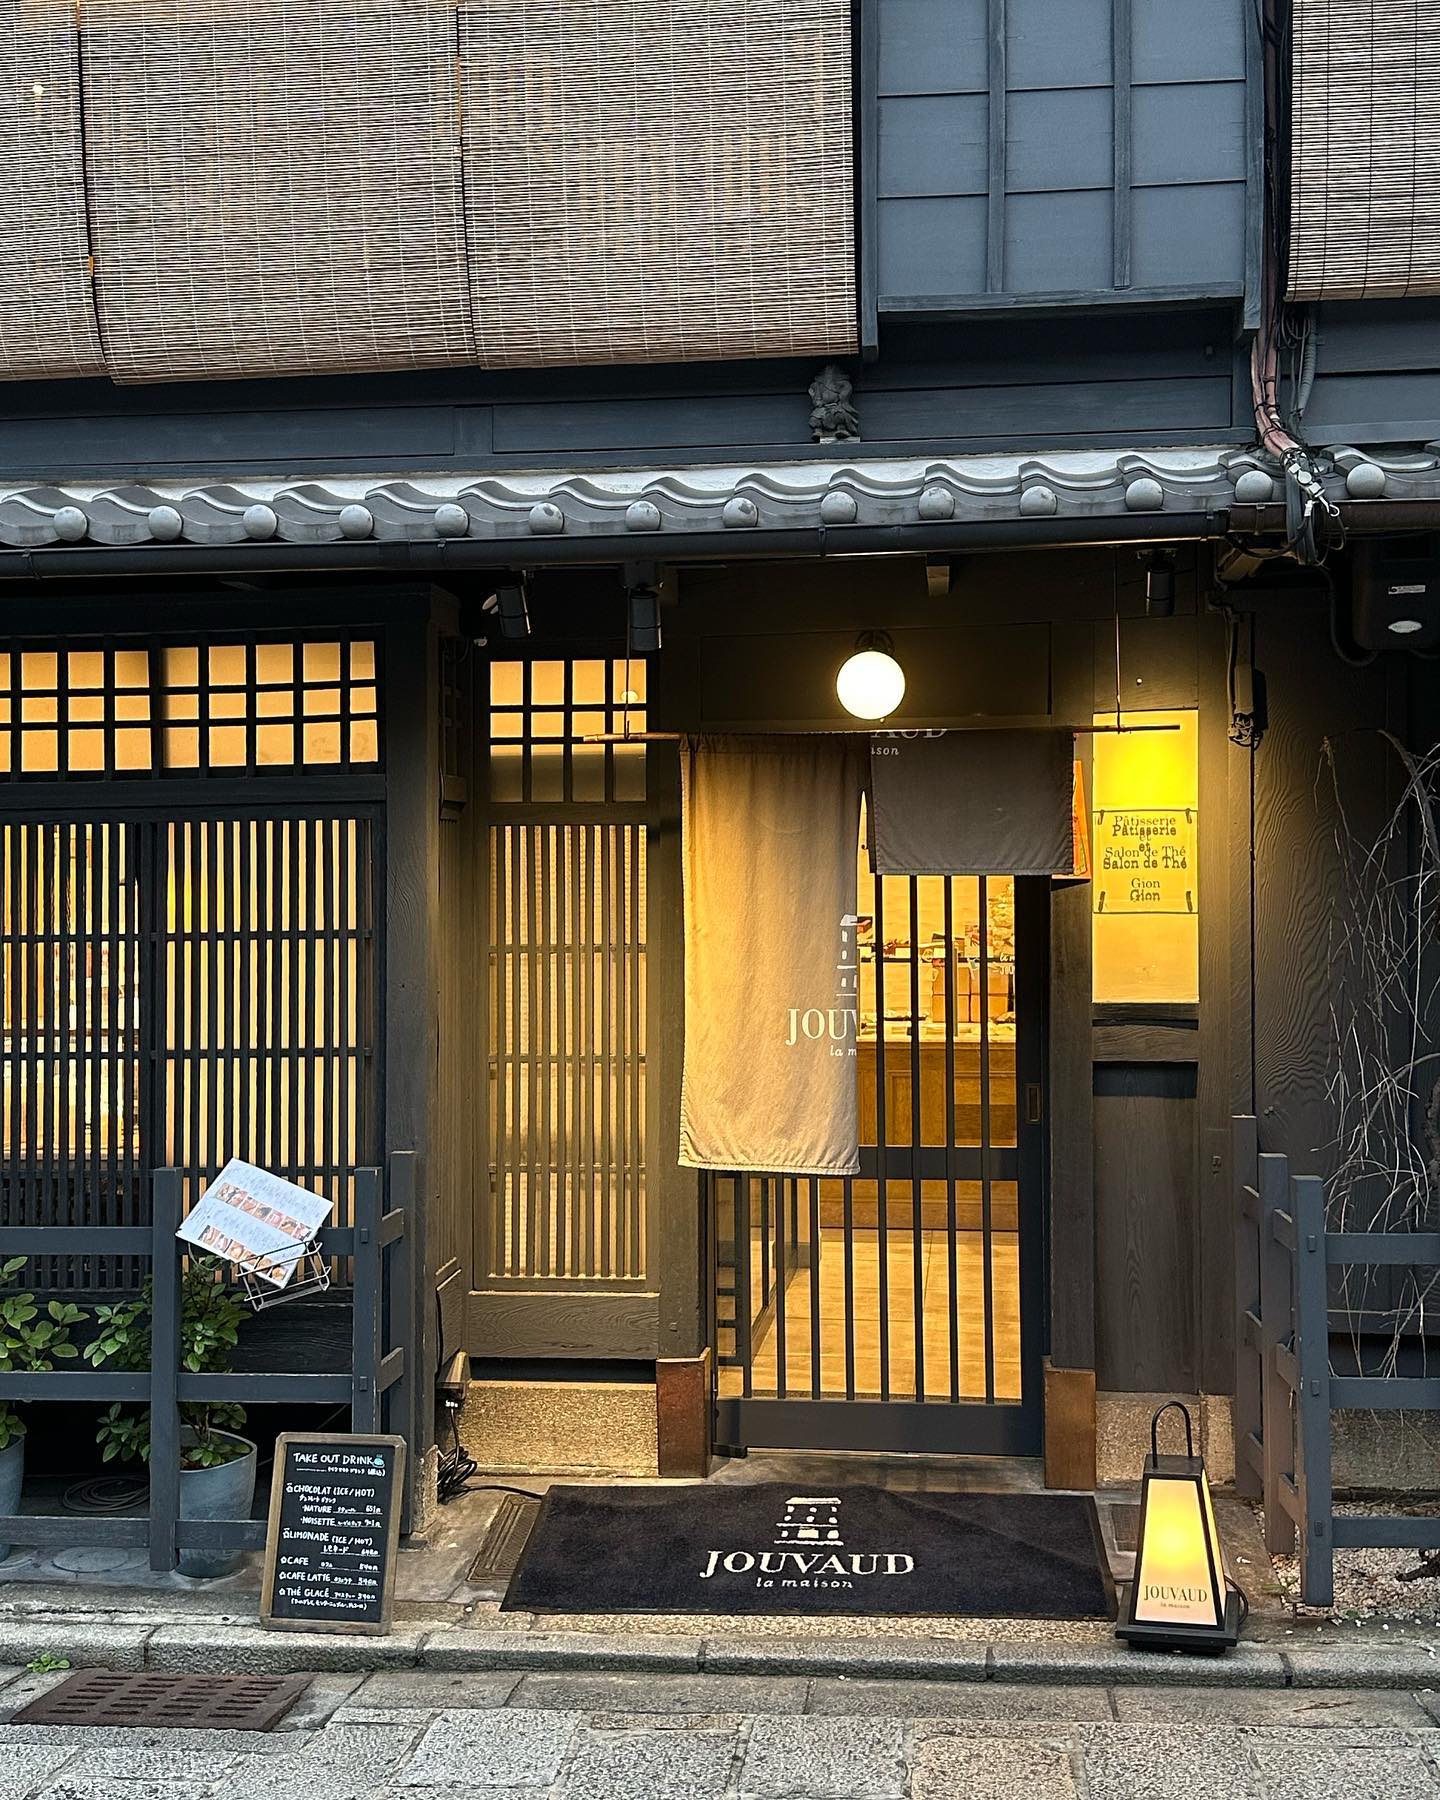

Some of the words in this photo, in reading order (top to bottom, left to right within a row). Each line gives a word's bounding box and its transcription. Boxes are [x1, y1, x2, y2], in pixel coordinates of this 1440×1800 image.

[1103, 857, 1139, 870] Salon
[1130, 889, 1161, 902] Gion
[785, 1008, 857, 1046] JOU
[830, 1045, 843, 1056] la
[293, 1453, 318, 1463] TAKE
[320, 1454, 341, 1463] OUT
[342, 1454, 373, 1465] DRINK
[293, 1484, 332, 1495] CHOCOLAT
[289, 1530, 329, 1542] LIMONADE
[287, 1556, 309, 1565] CAFE
[700, 1550, 915, 1578] JOUVAUD
[286, 1571, 306, 1581] CAFE
[307, 1573, 331, 1582] LATTE
[756, 1577, 774, 1588] la
[782, 1577, 853, 1588] maison
[1143, 1585, 1207, 1603] JOUVAUD
